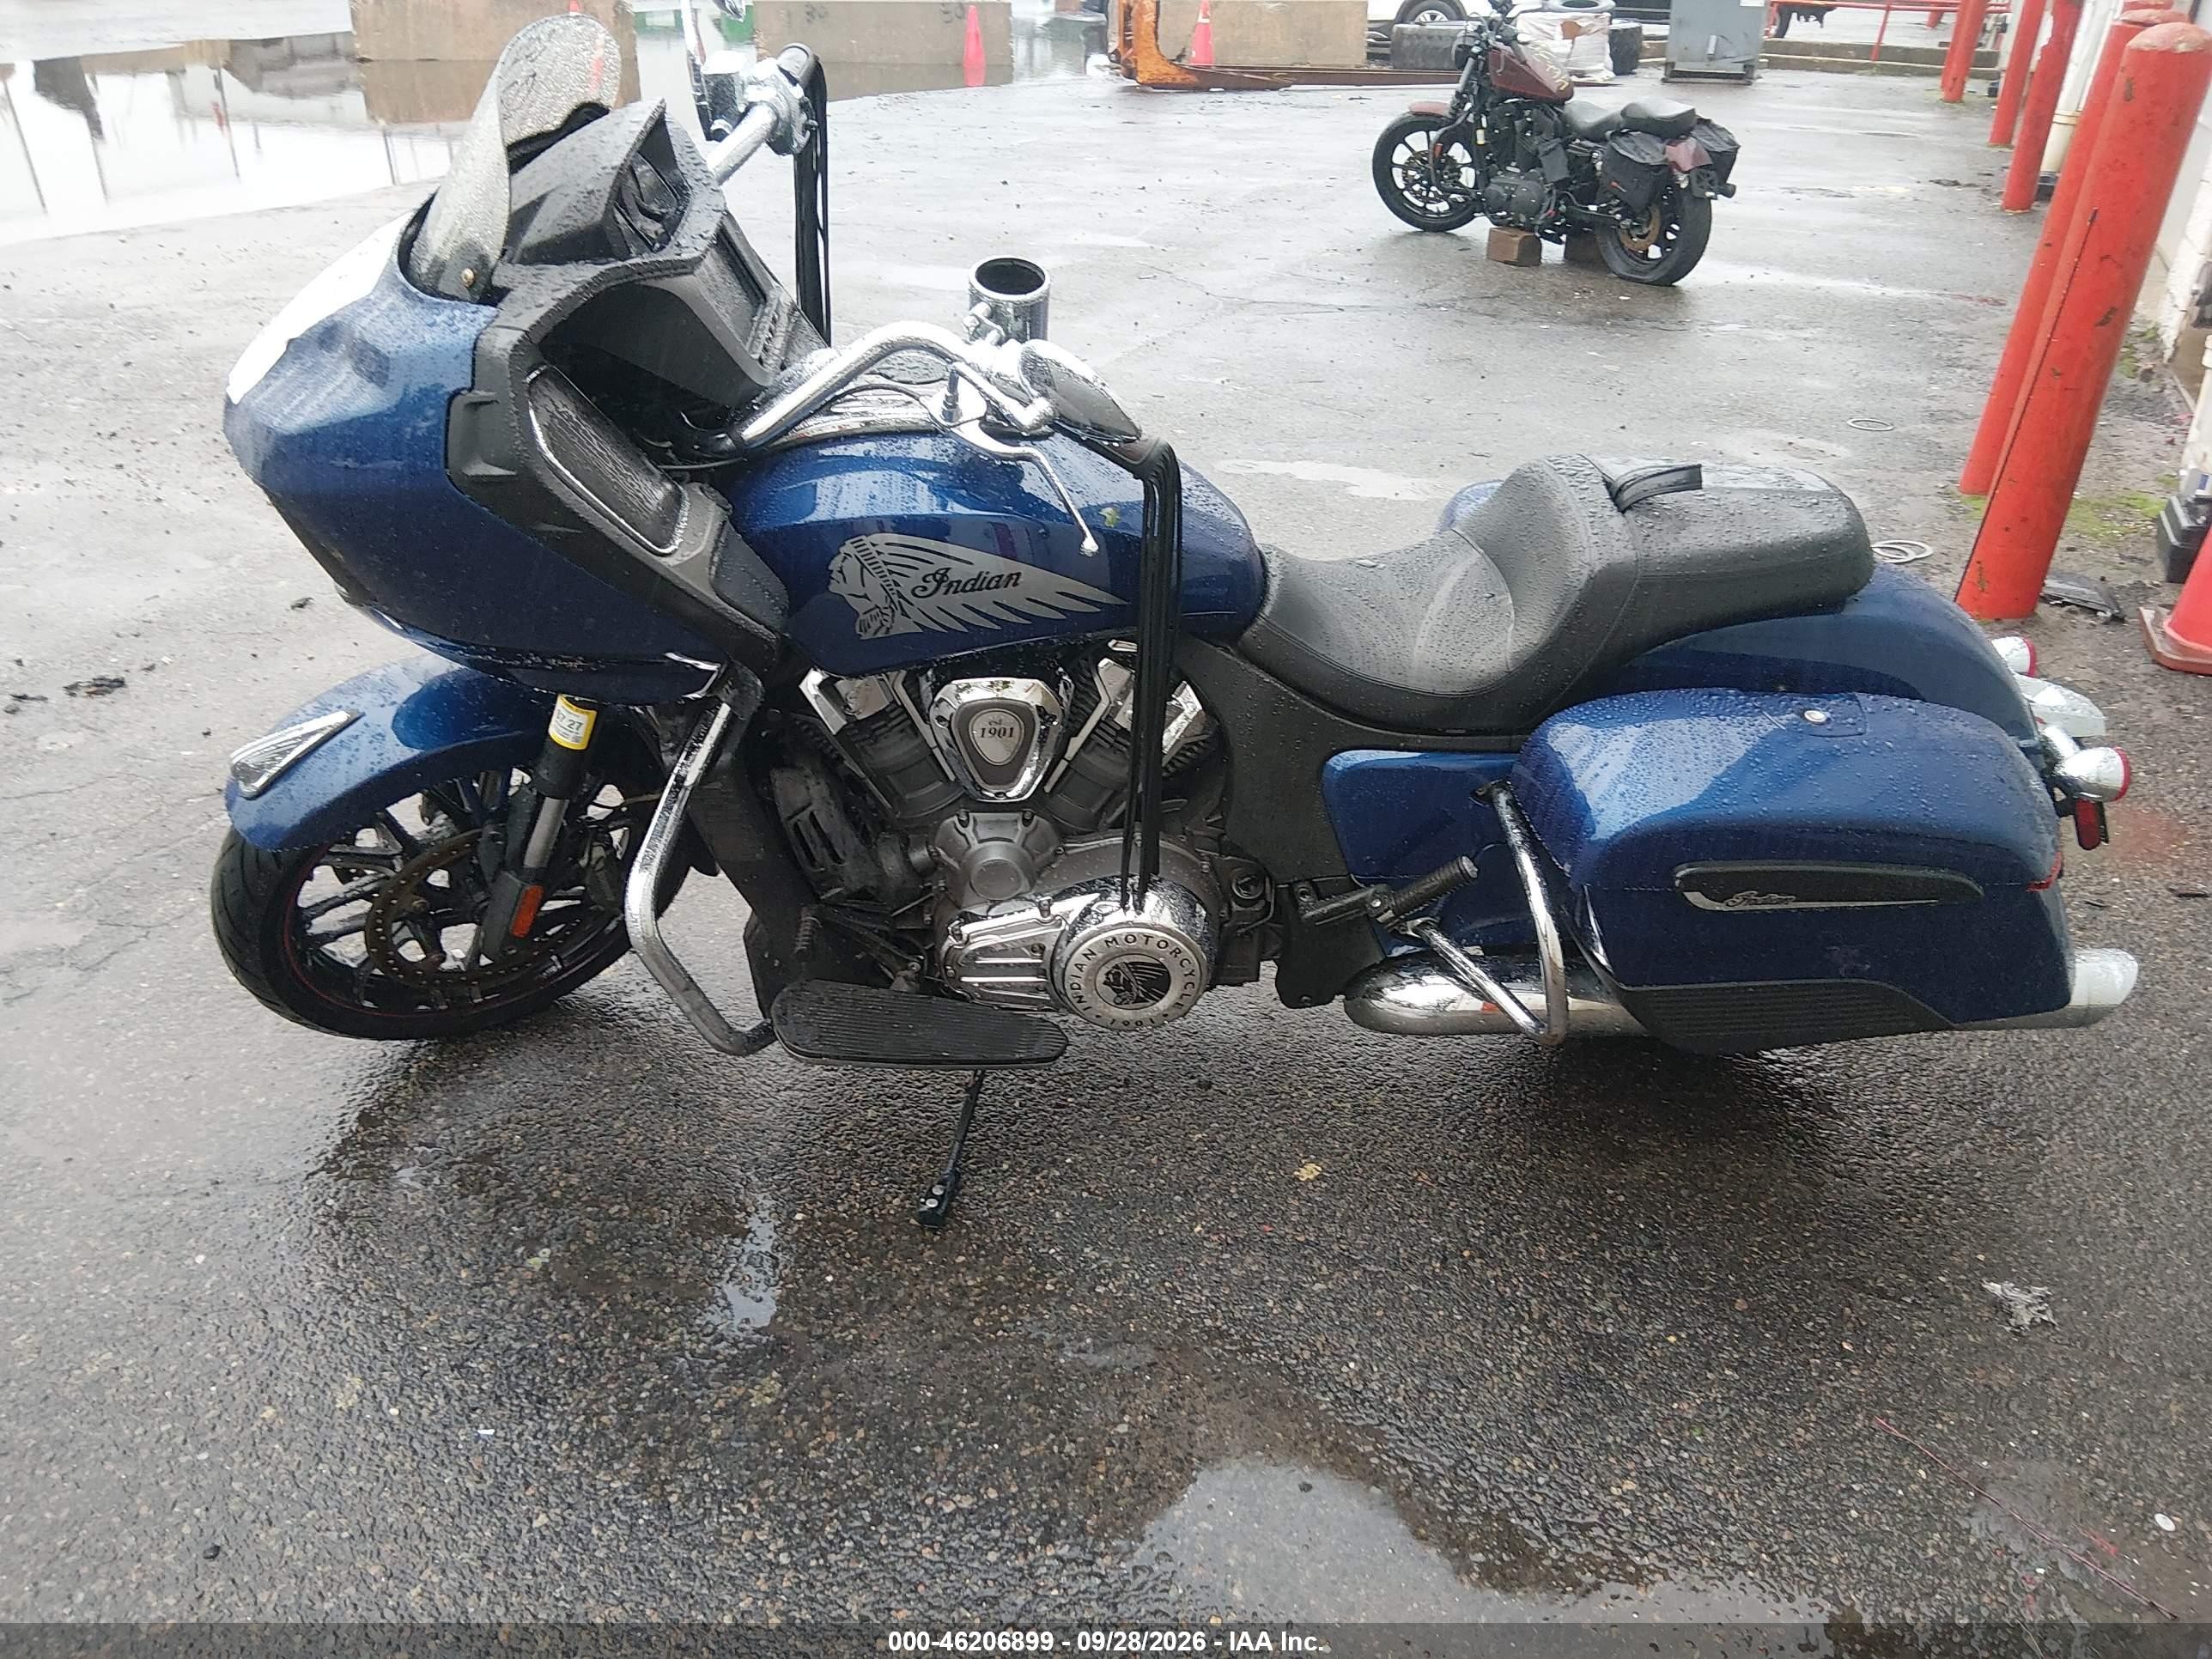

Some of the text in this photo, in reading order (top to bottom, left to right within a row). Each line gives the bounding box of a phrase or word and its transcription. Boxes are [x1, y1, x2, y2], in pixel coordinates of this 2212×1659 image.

[911, 567, 1022, 599] Indian
[981, 726, 1014, 738] 1901
[1070, 933, 1196, 1012] INDIAN MOTORCYCLE
